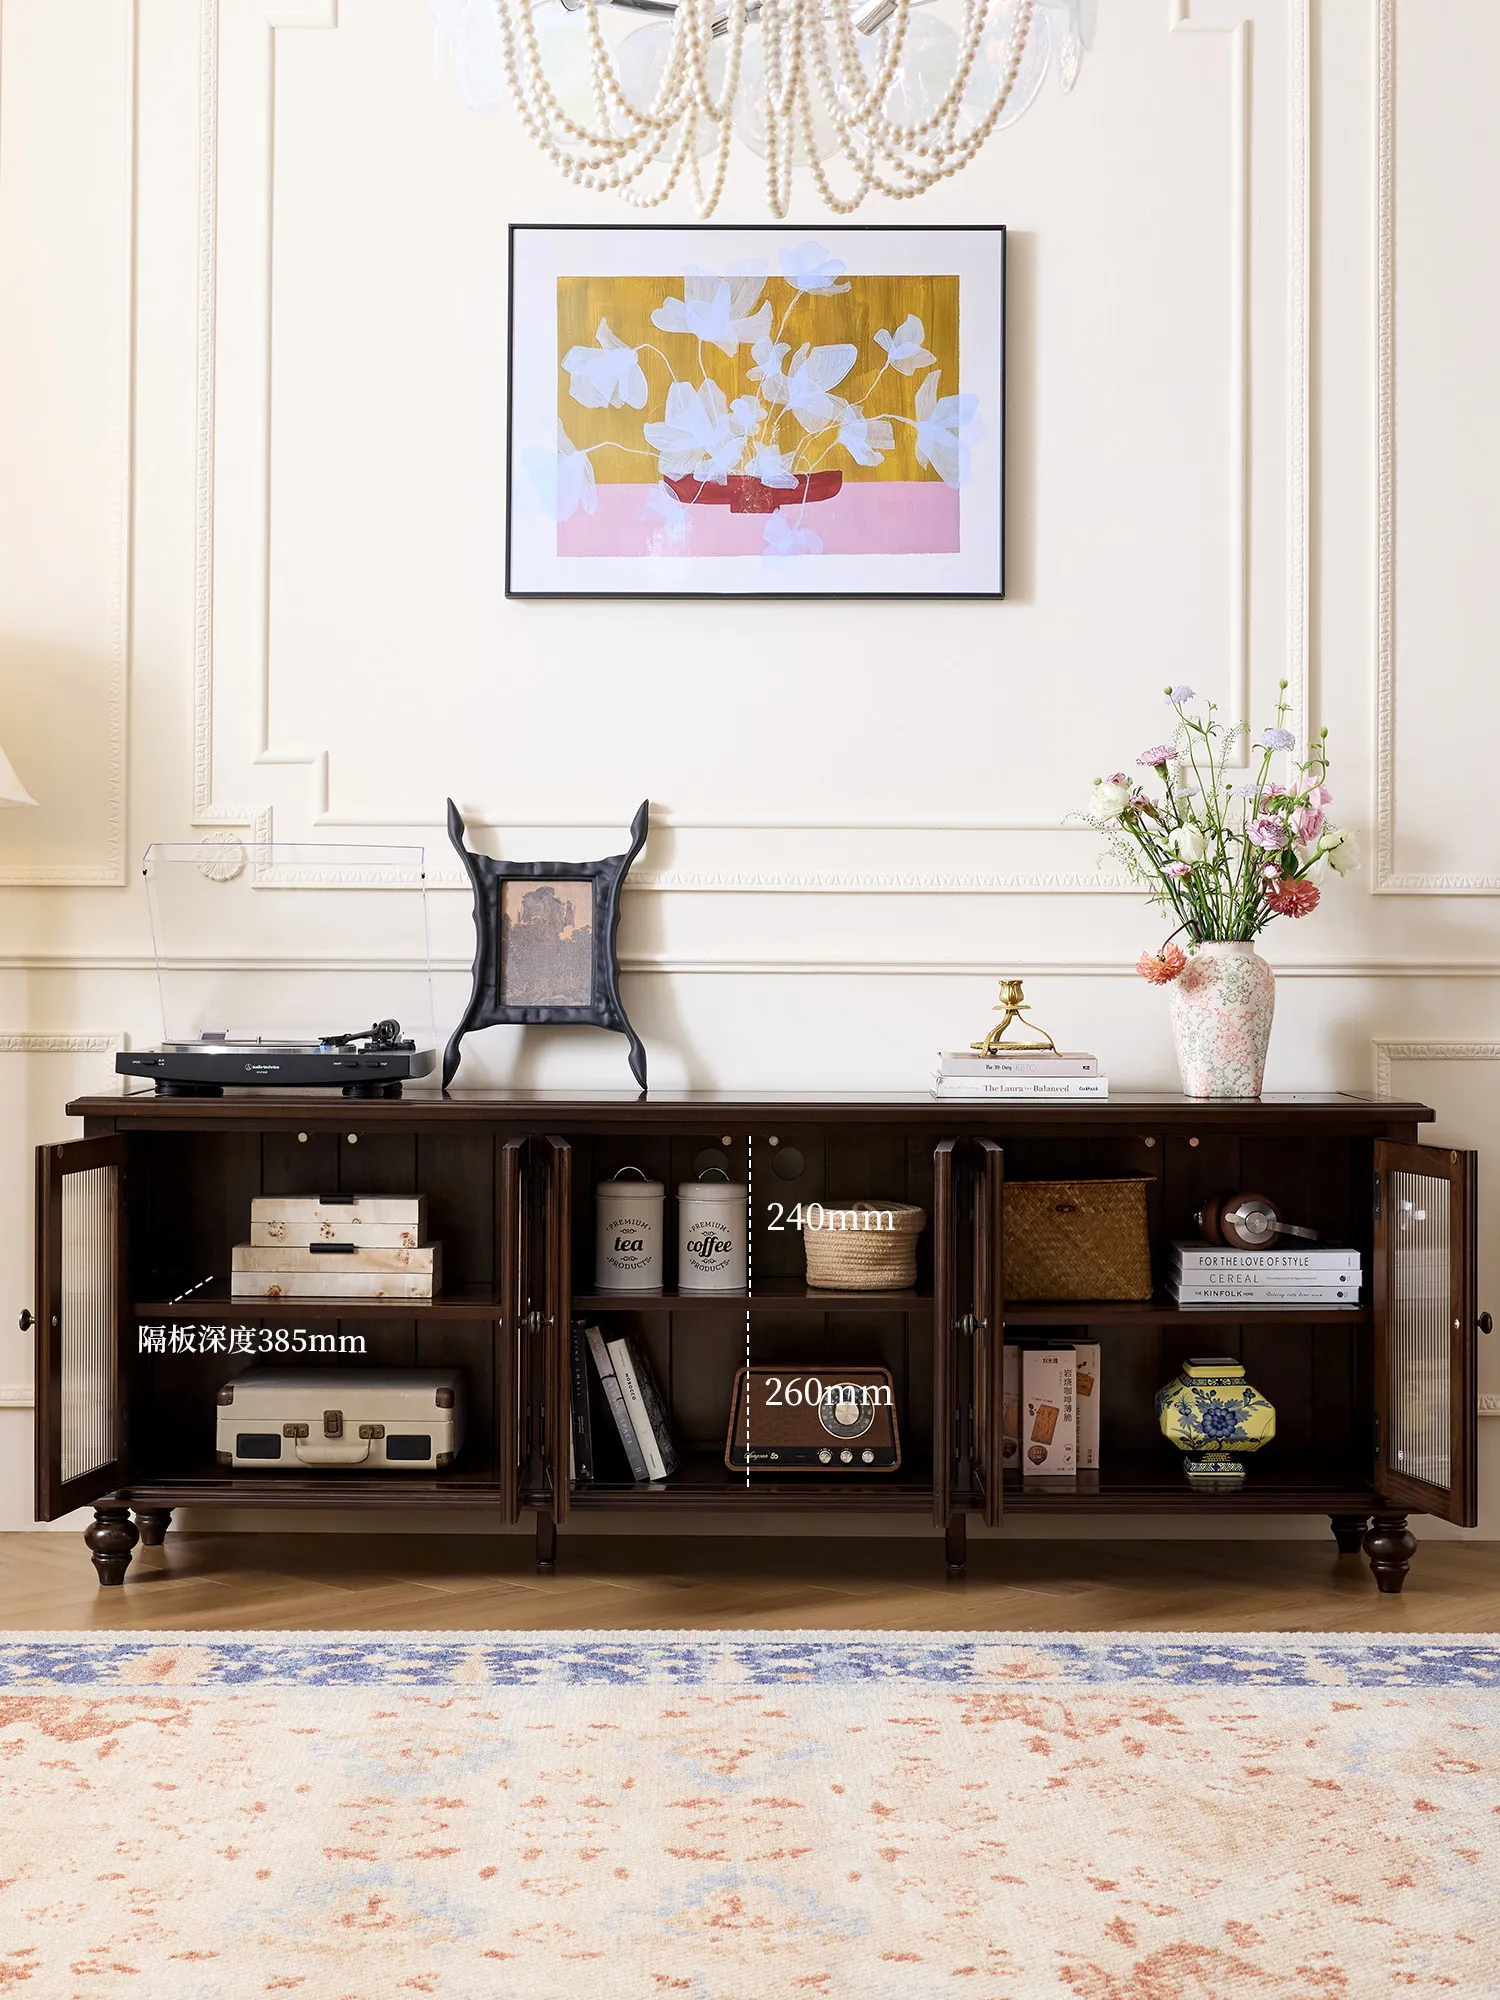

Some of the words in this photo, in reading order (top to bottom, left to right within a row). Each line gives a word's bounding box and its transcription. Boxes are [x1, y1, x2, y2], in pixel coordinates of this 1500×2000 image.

[983, 1084, 1000, 1092] The
[1000, 1084, 1024, 1092] Laura
[1033, 1084, 1070, 1092] Balanced
[608, 1218, 649, 1230] PREMIUM
[691, 1221, 728, 1232] PREMIUM
[614, 1236, 644, 1252] tea
[686, 1236, 733, 1258] coffee
[608, 1257, 651, 1270] PRODUCTS
[691, 1259, 728, 1272] PRODUCTS
[1199, 1256, 1218, 1267] FOR
[1220, 1256, 1237, 1267] THE
[1240, 1256, 1264, 1267] LOVE
[1266, 1256, 1280, 1267] OF
[1282, 1256, 1309, 1267] STYLE
[1209, 1273, 1259, 1284] CEREAL
[625, 1372, 637, 1401] MOROCCO
